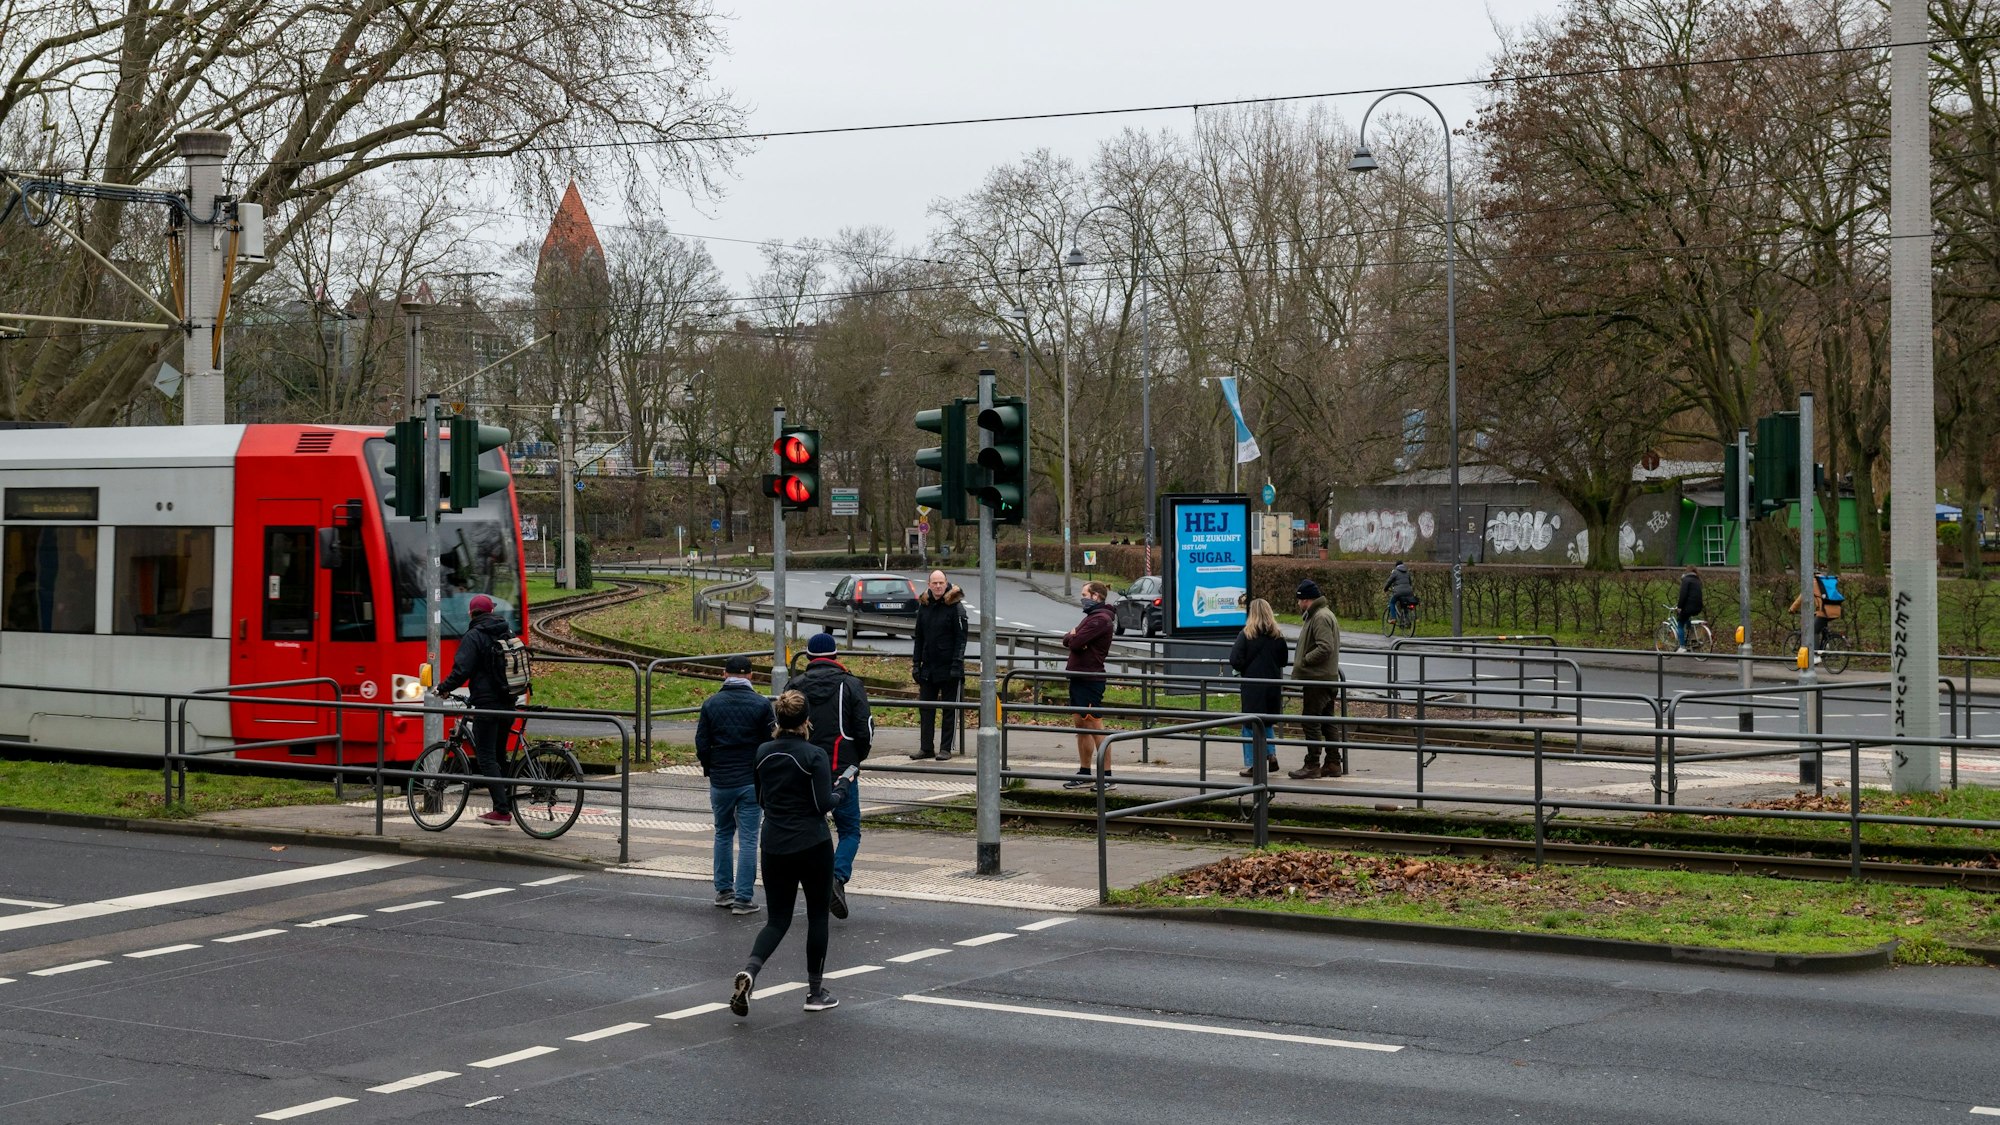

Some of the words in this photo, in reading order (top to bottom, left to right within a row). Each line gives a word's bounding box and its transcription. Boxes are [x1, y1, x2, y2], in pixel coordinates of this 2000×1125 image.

[1192, 534, 1205, 542] DIE
[1206, 533, 1241, 542] ZUKUNFT
[1189, 552, 1235, 563] SUGAR.
